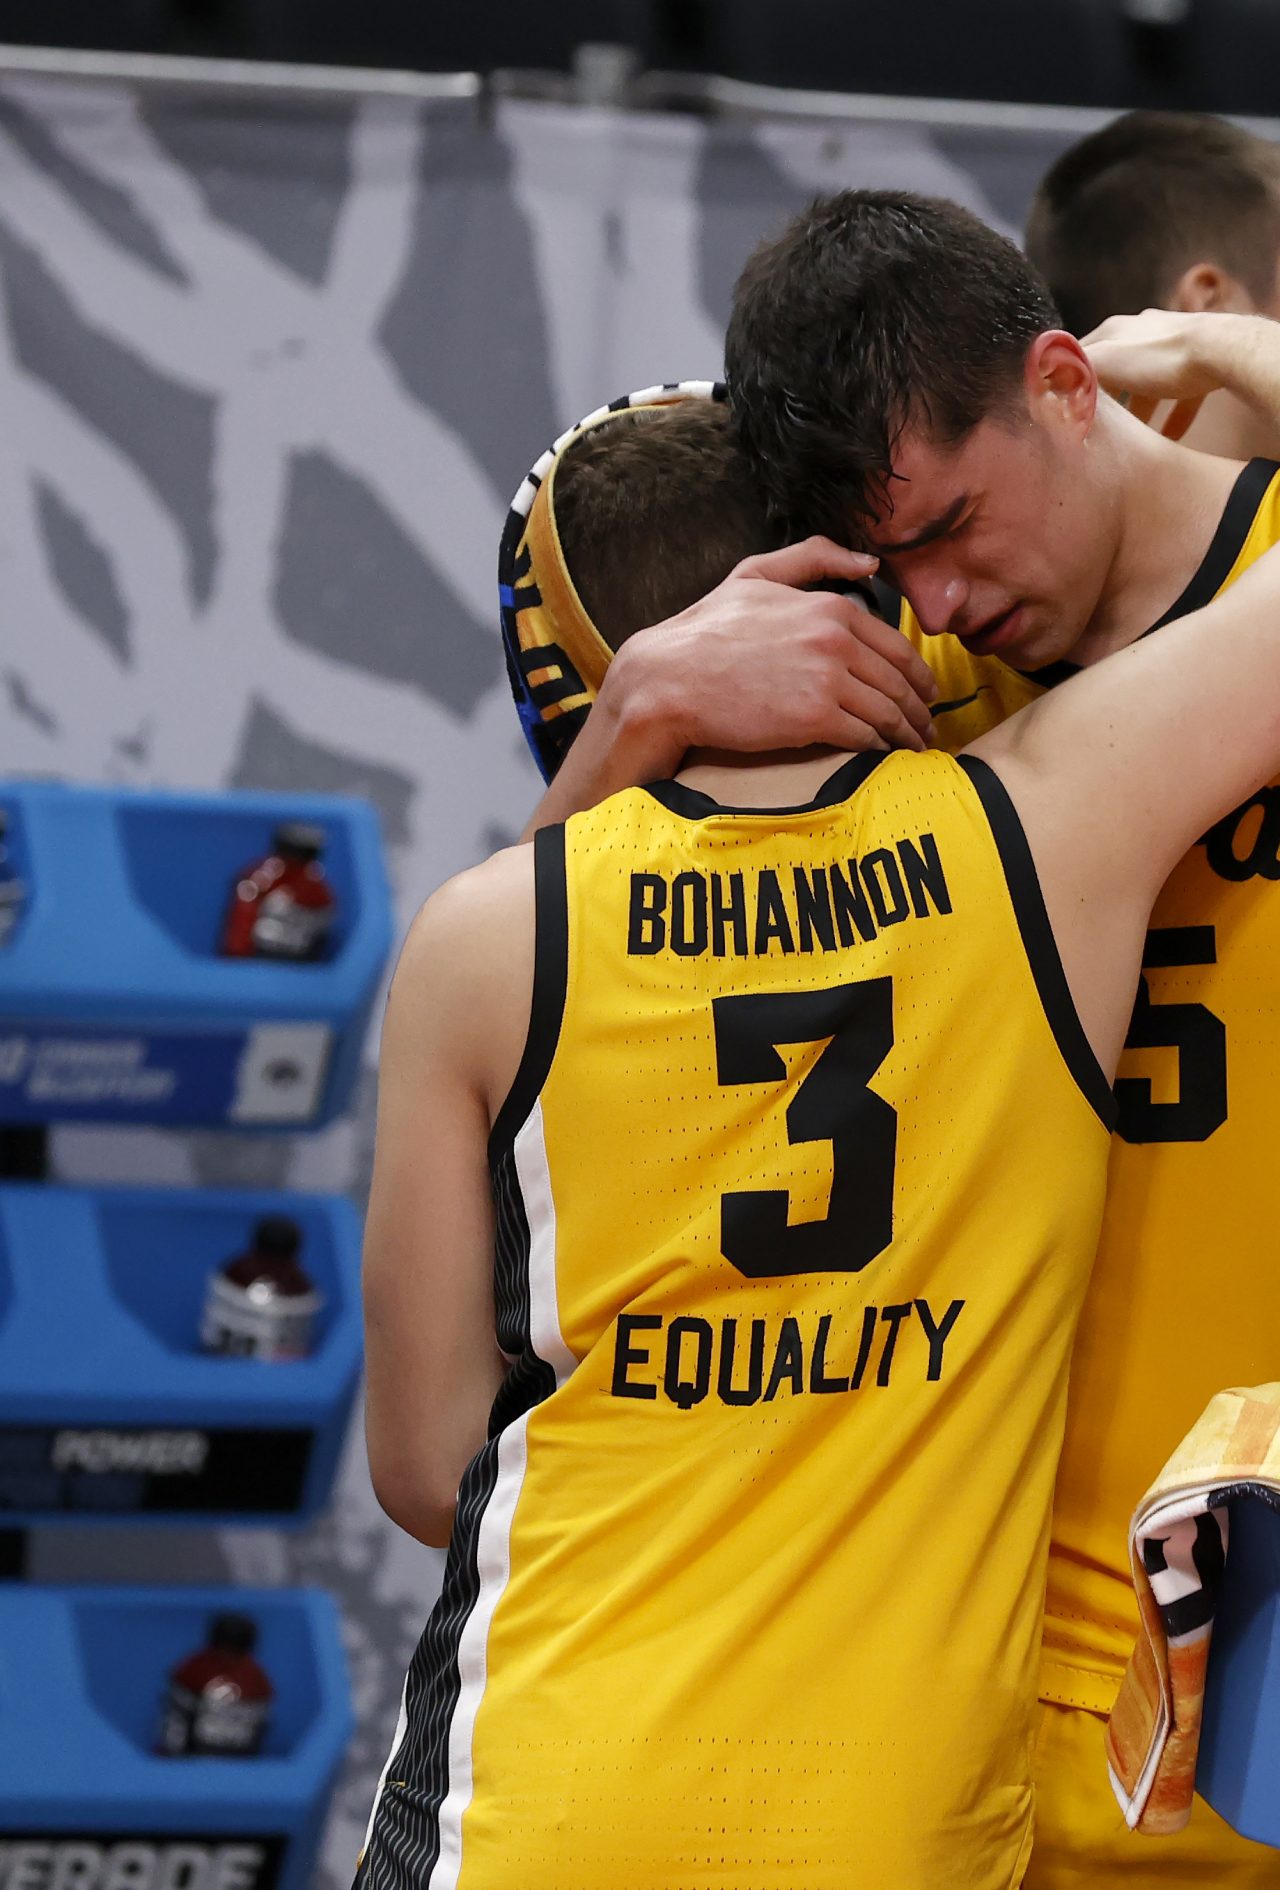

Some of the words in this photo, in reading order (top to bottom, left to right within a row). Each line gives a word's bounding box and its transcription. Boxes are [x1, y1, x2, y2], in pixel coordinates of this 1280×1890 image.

[627, 833, 953, 957] BOHANNON
[712, 976, 898, 1278] 3
[611, 1299, 965, 1409] EQUALITY
